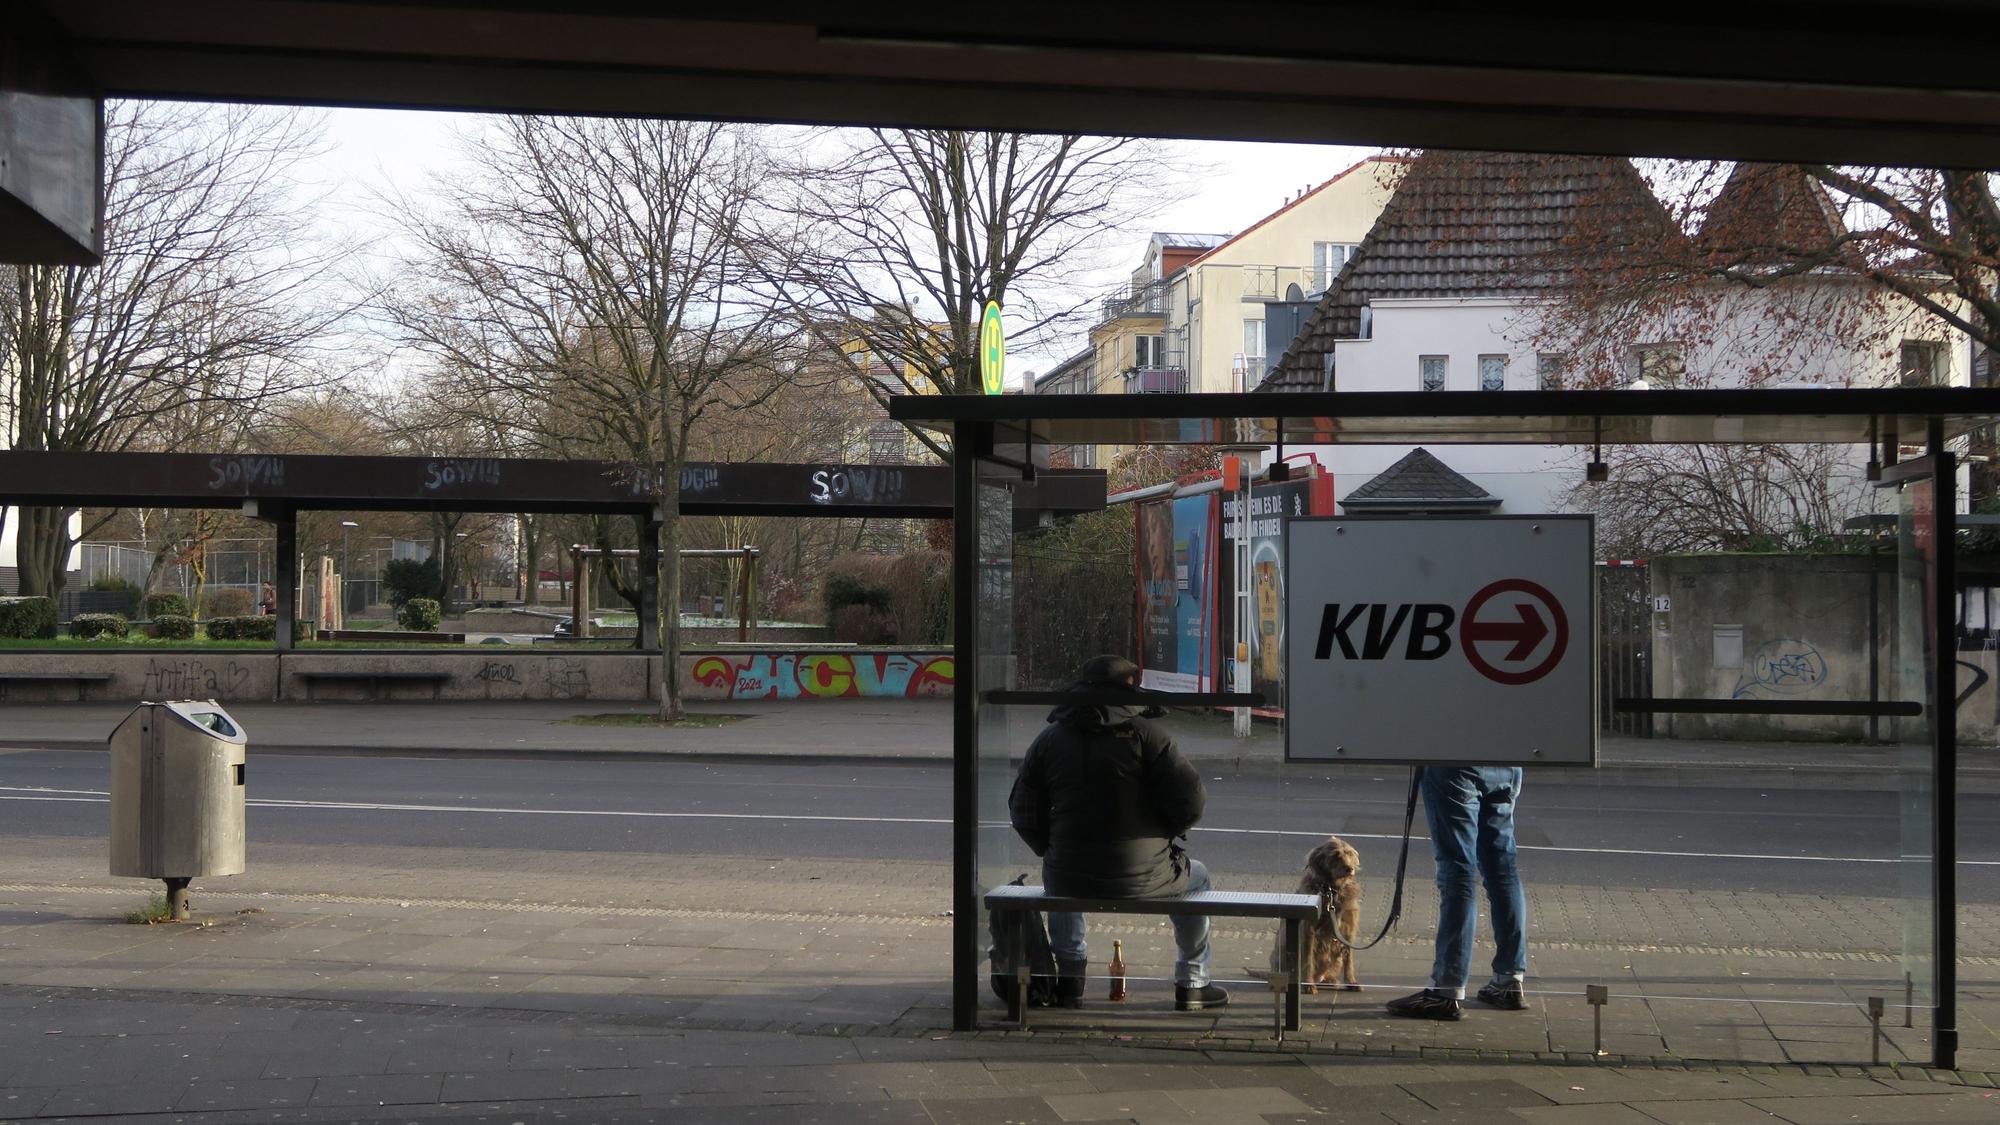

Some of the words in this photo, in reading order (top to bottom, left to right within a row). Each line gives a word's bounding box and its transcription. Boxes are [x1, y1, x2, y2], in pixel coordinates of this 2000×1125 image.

[1263, 496, 1272, 514] ES
[1656, 599, 1670, 610] 12
[1314, 603, 1456, 660] KVB
